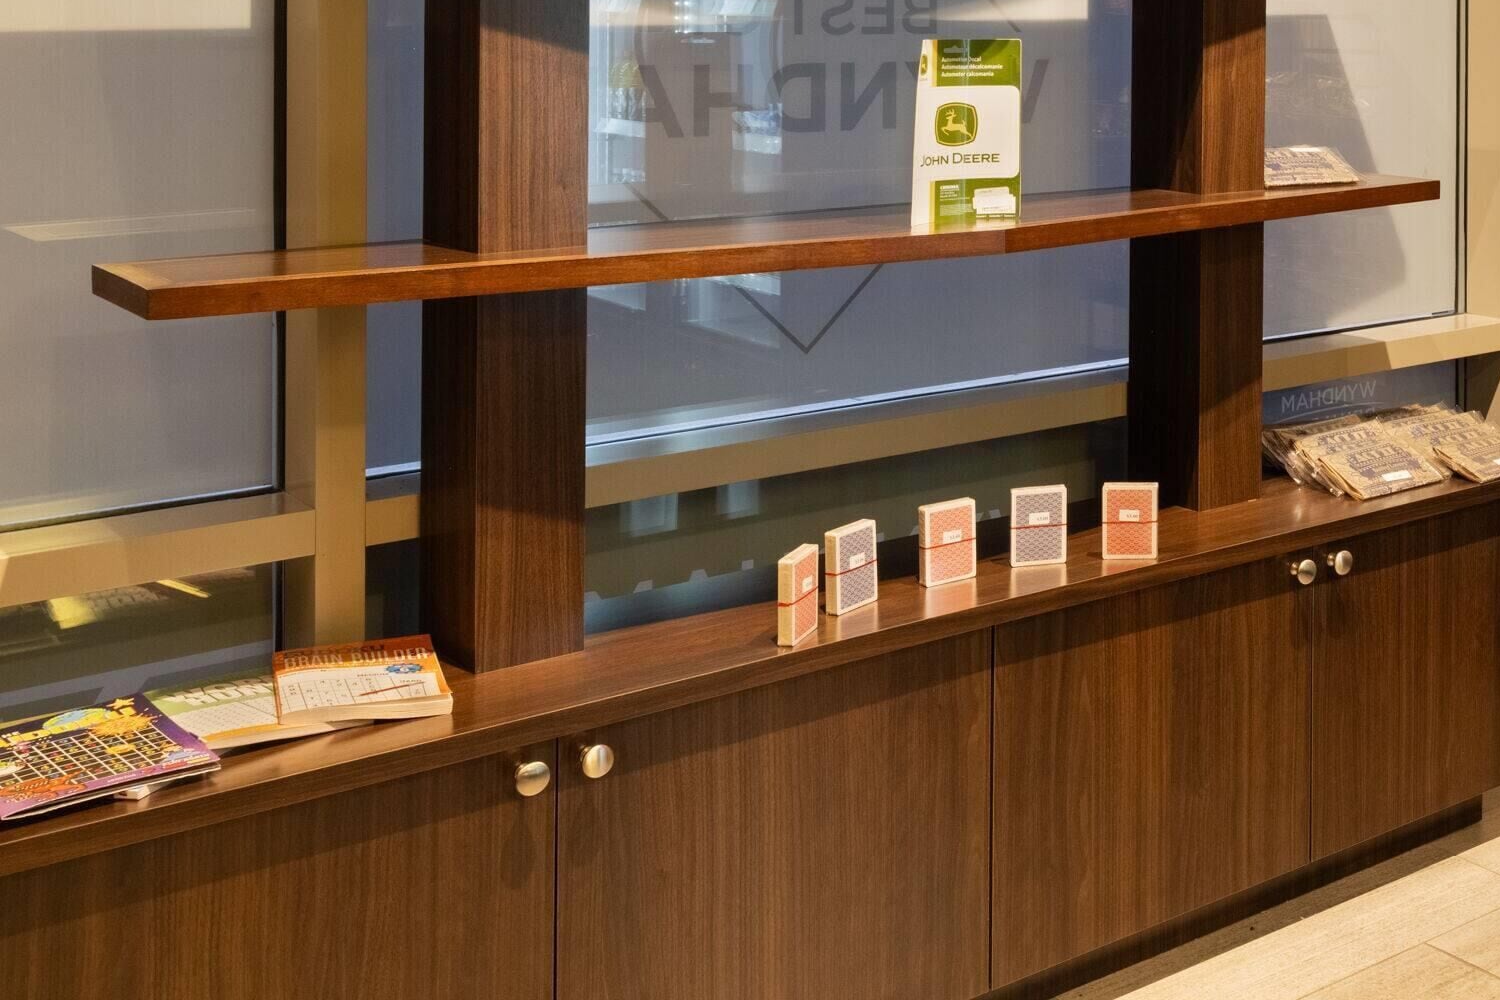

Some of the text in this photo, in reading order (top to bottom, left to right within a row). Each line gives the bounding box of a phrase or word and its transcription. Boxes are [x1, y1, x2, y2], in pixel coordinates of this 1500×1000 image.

[920, 152, 1000, 168] JOHN DEERE
[284, 651, 343, 670] BRAIN
[352, 646, 429, 664] BUILDER
